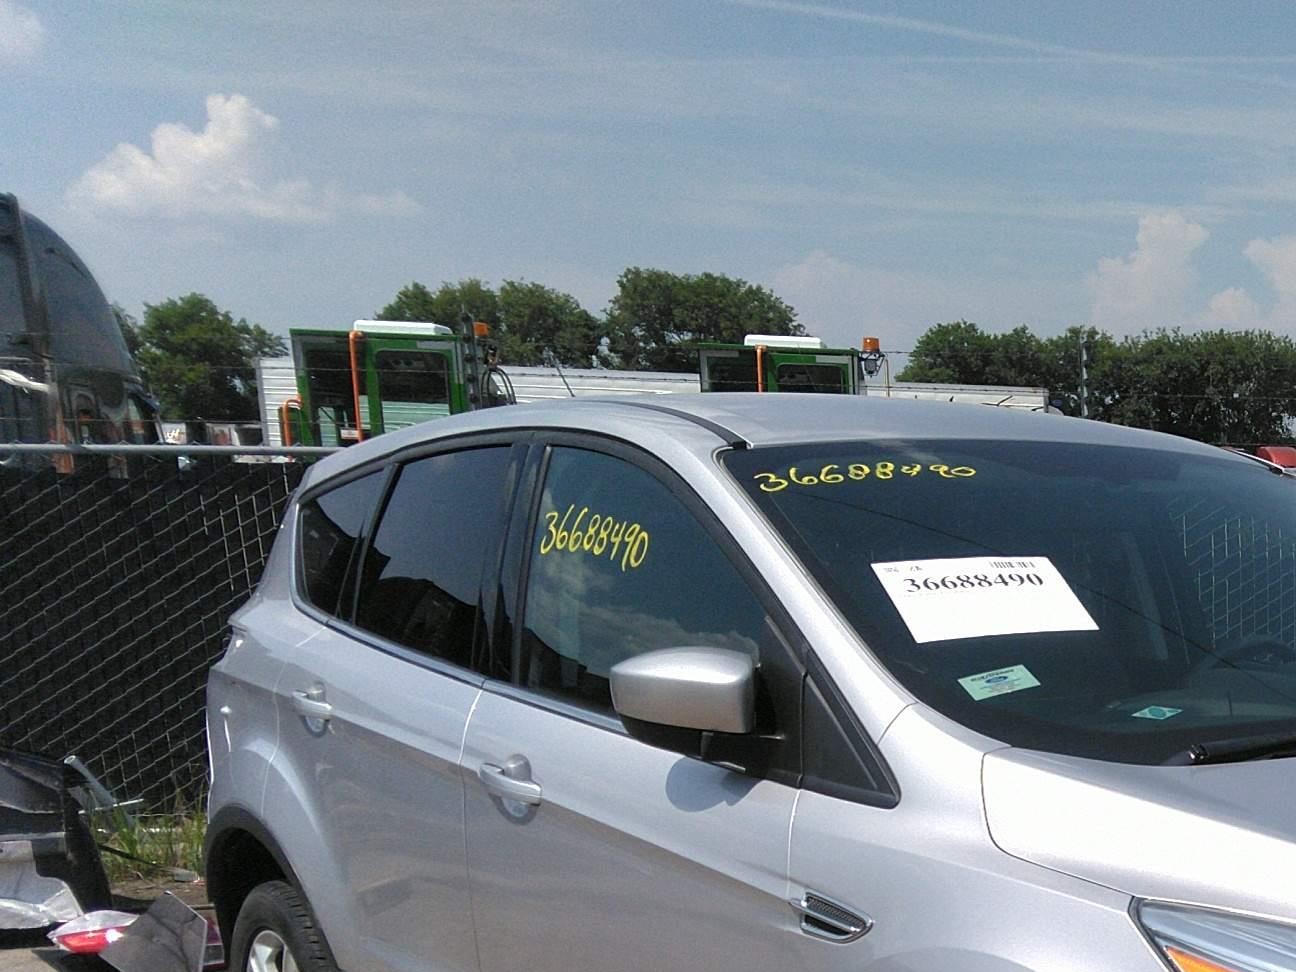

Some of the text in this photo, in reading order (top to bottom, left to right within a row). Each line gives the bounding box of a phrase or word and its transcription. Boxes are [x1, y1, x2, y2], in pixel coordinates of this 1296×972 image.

[754, 461, 977, 492] 36688490
[540, 503, 649, 572] 36688490
[903, 573, 1044, 593] 36688490
